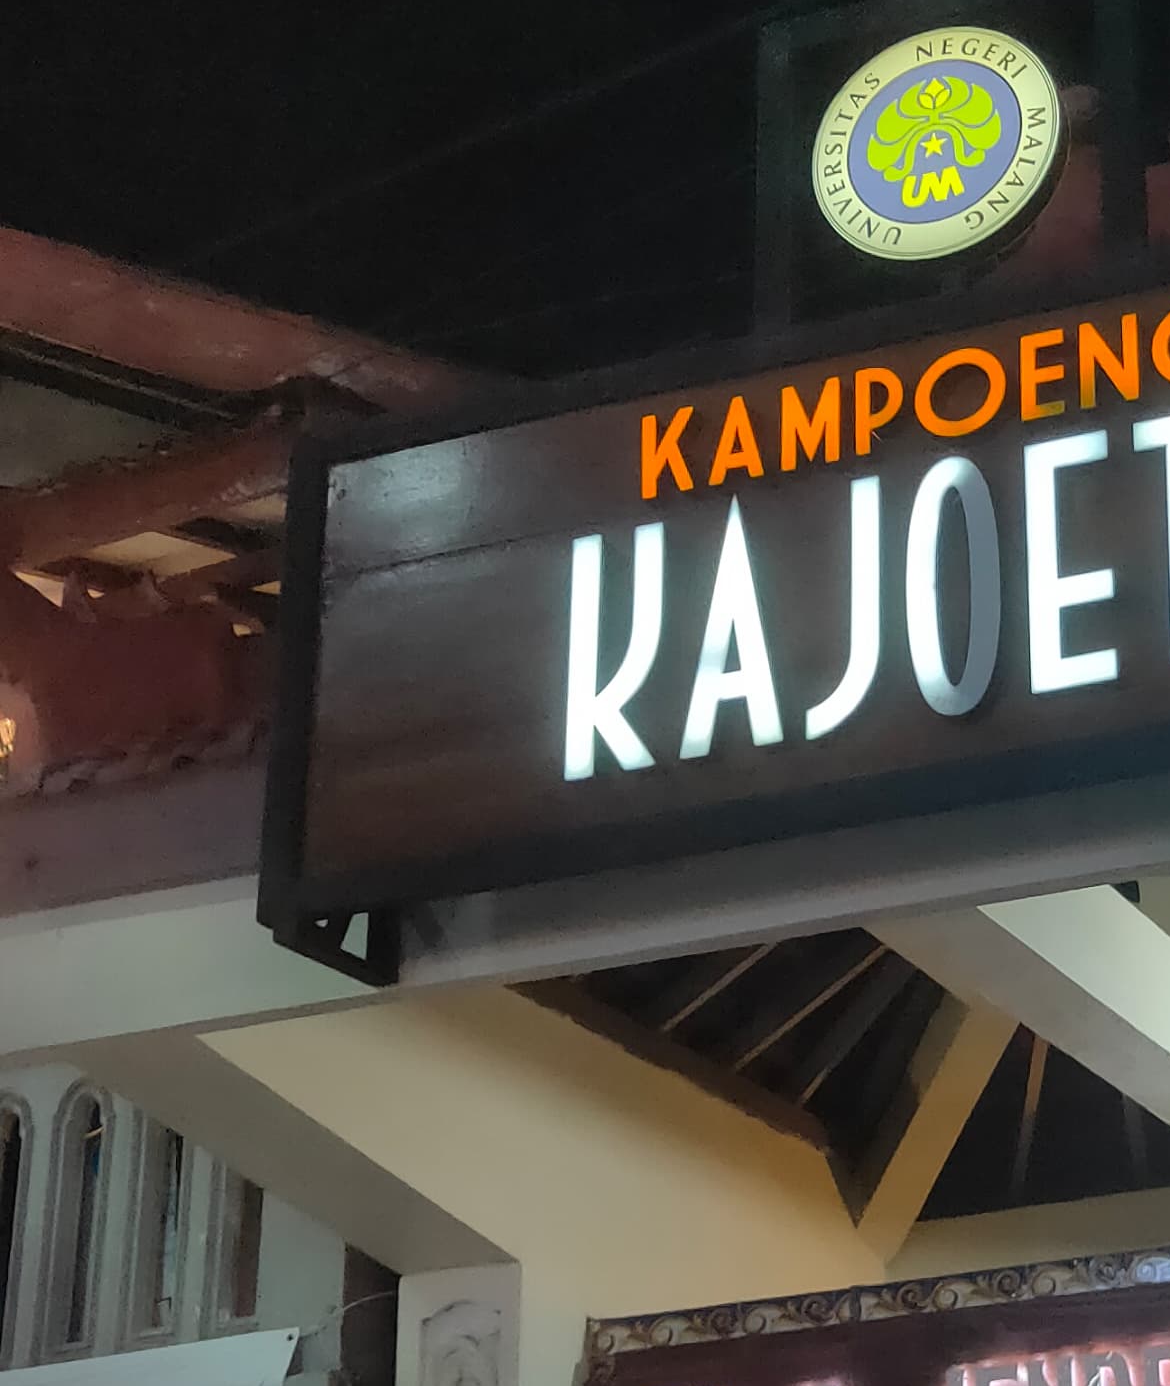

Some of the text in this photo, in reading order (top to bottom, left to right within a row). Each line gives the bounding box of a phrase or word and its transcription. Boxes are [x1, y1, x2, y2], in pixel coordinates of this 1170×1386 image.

[823, 37, 1047, 246] UNIVERSITAS NEGERI MALANG
[901, 165, 965, 208] UM
